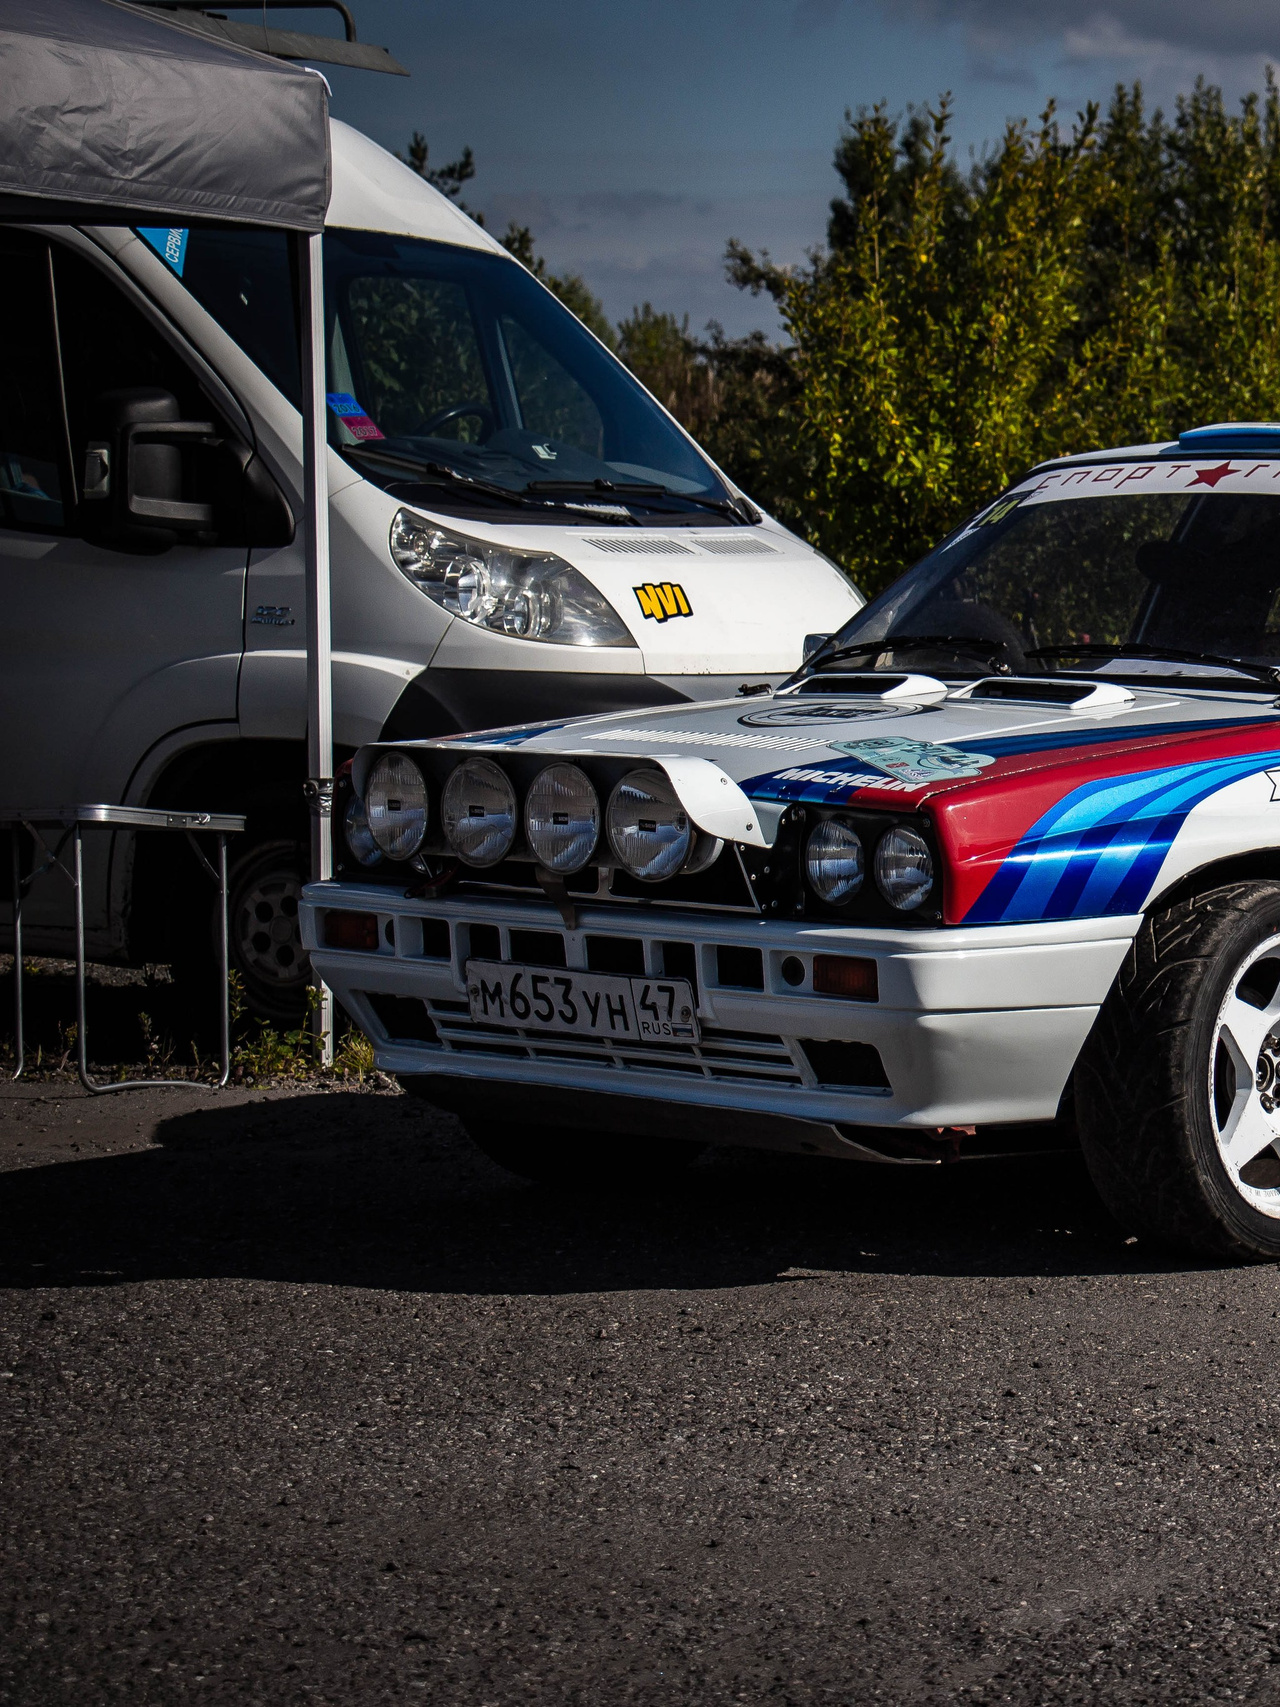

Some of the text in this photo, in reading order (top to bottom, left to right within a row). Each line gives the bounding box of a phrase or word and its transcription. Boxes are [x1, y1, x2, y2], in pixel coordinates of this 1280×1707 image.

[772, 768, 931, 792] MICHELIN
[640, 984, 676, 1022] 47
[641, 1021, 672, 1036] RUS
